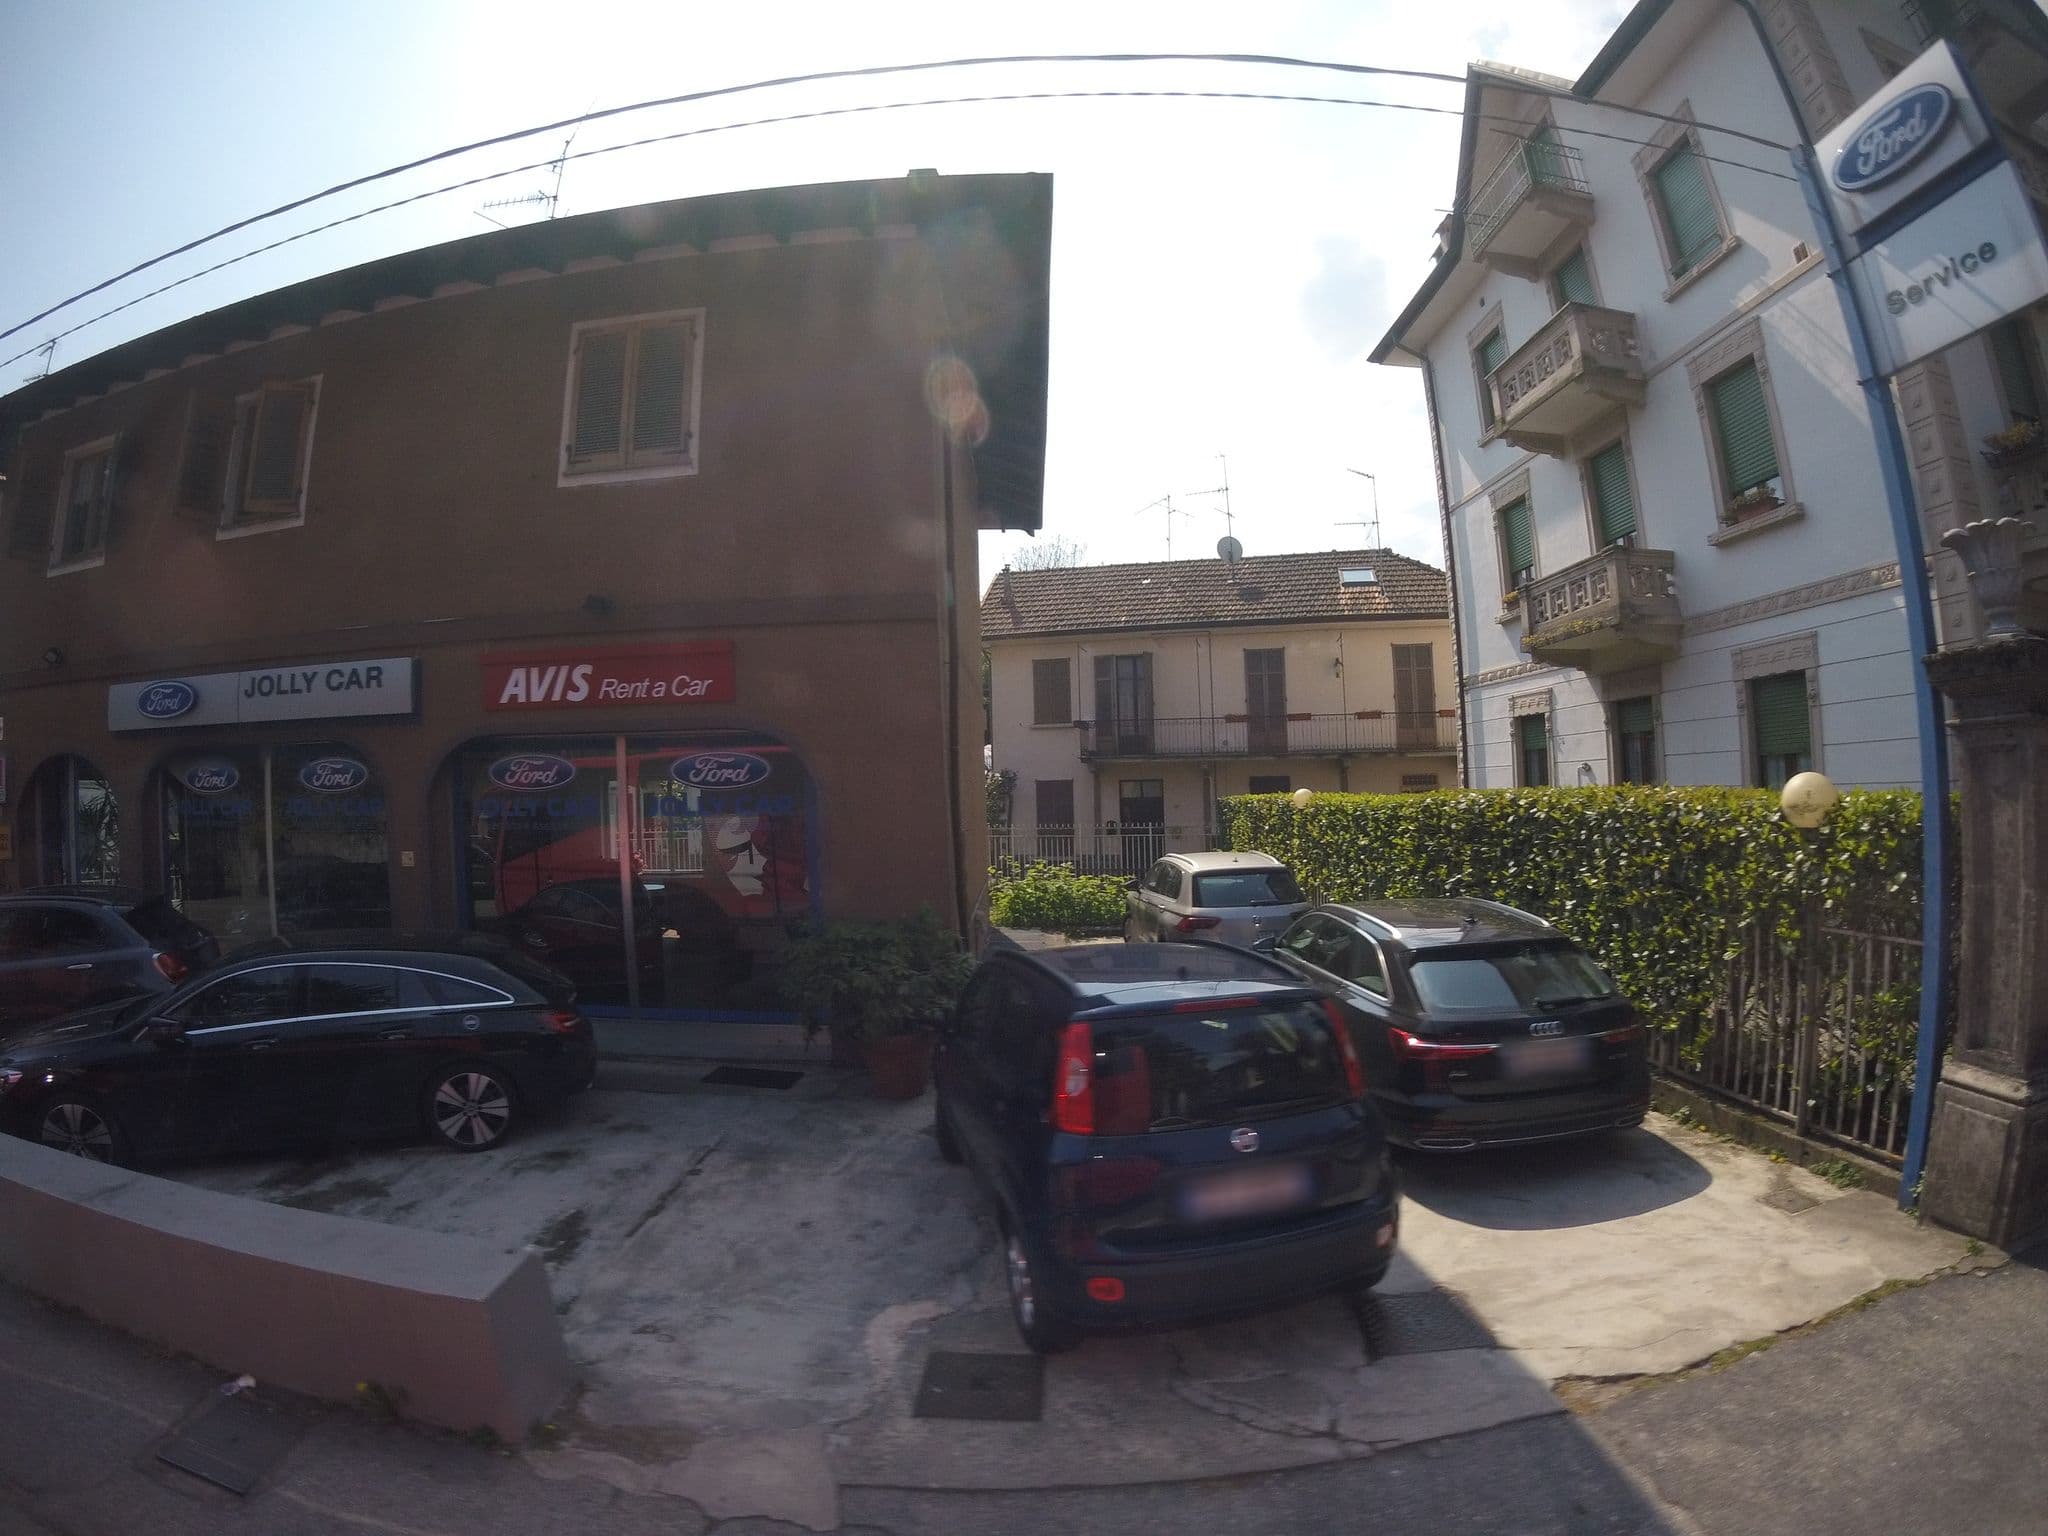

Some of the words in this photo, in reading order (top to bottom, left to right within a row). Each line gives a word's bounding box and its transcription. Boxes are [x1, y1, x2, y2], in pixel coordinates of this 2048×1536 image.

[1856, 103, 1928, 176] Ford
[1886, 240, 1999, 317] Service
[244, 671, 318, 699] JOLLY
[324, 665, 384, 693] CAR
[499, 663, 594, 704] AVIS
[598, 677, 649, 700] Rent
[652, 681, 667, 699] a
[671, 674, 714, 698] Car
[146, 687, 184, 713] Ford
[192, 766, 228, 789] Ford
[313, 762, 355, 788] Ford
[504, 756, 558, 786] Ford
[688, 755, 750, 783] Ford
